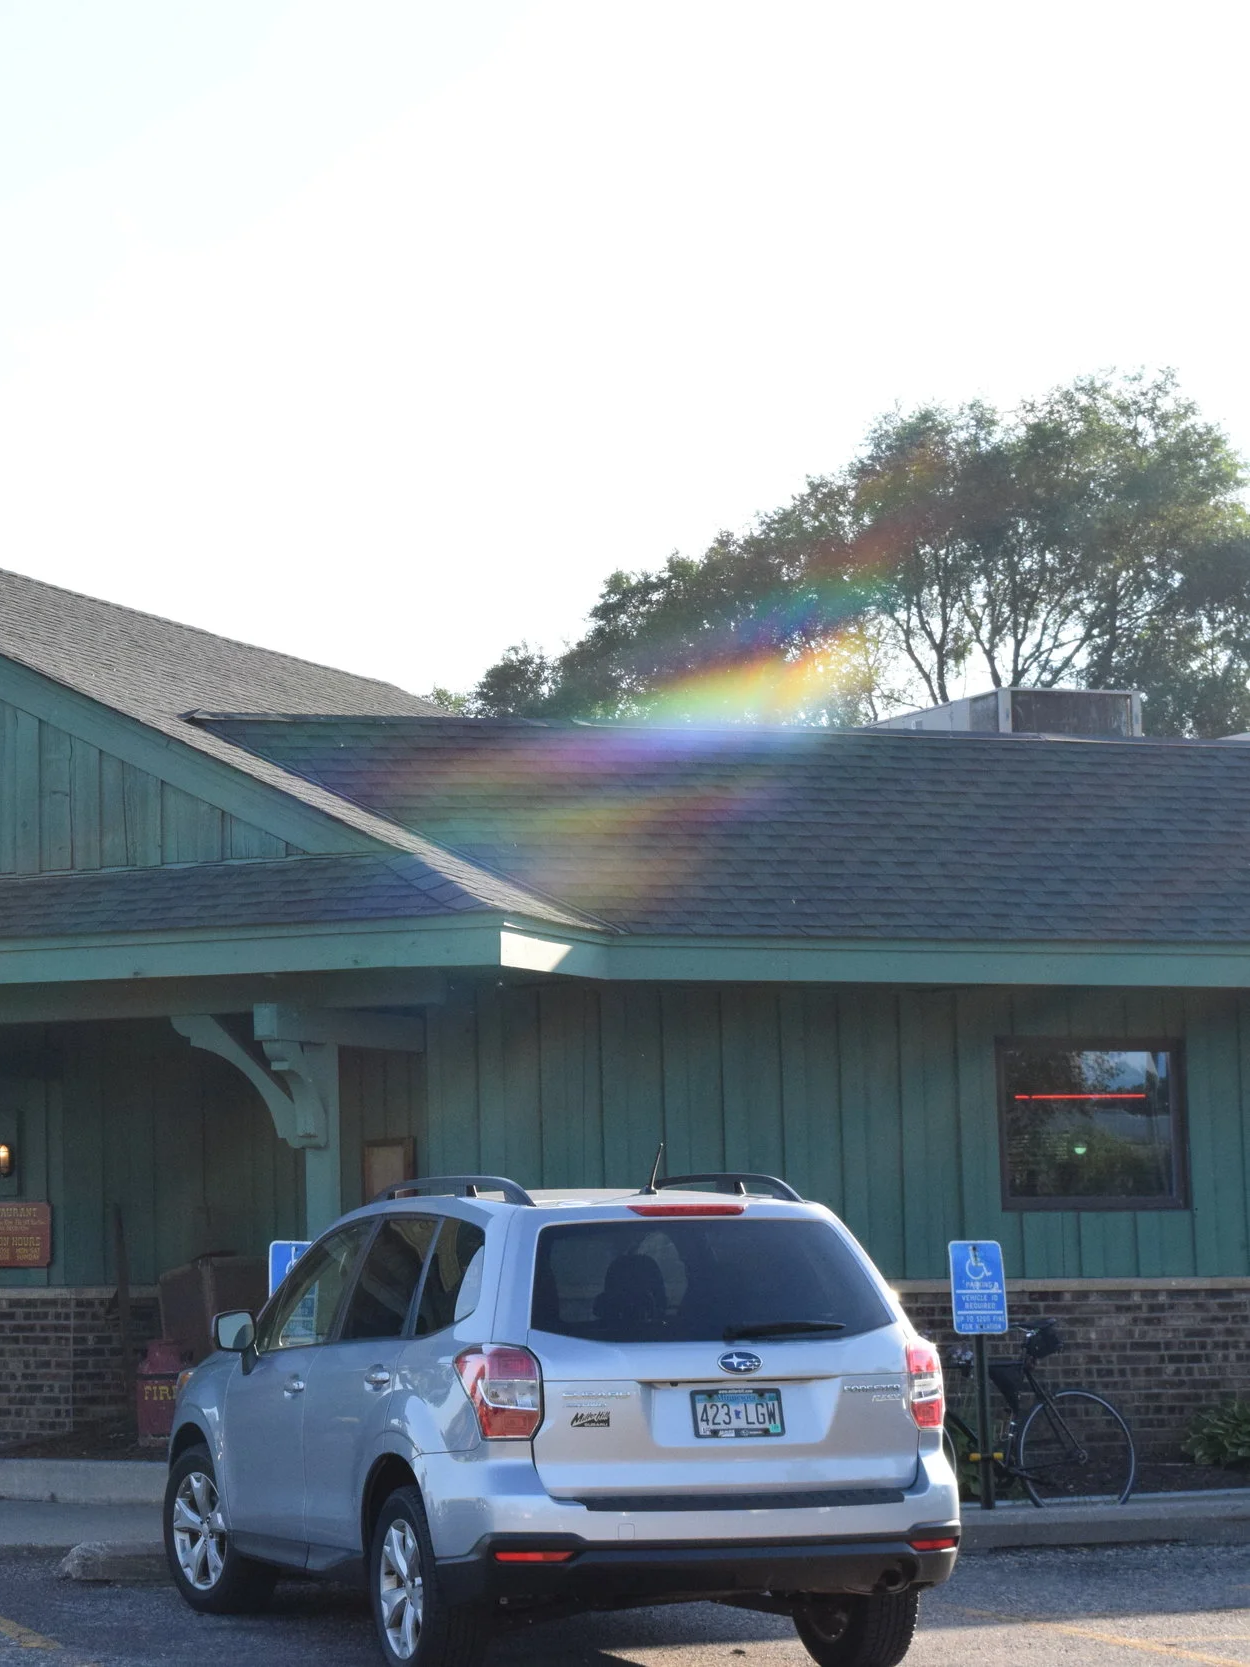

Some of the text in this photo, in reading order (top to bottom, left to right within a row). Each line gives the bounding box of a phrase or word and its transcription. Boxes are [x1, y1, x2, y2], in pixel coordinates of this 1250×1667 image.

[12, 1236, 41, 1247] HOURS
[961, 1294, 999, 1302] VEHICLE ID
[964, 1302, 996, 1310] REQUIRED
[843, 1383, 901, 1392] FORESTER
[717, 1394, 756, 1402] Minnesota
[700, 1402, 777, 1425] 423 LGW
